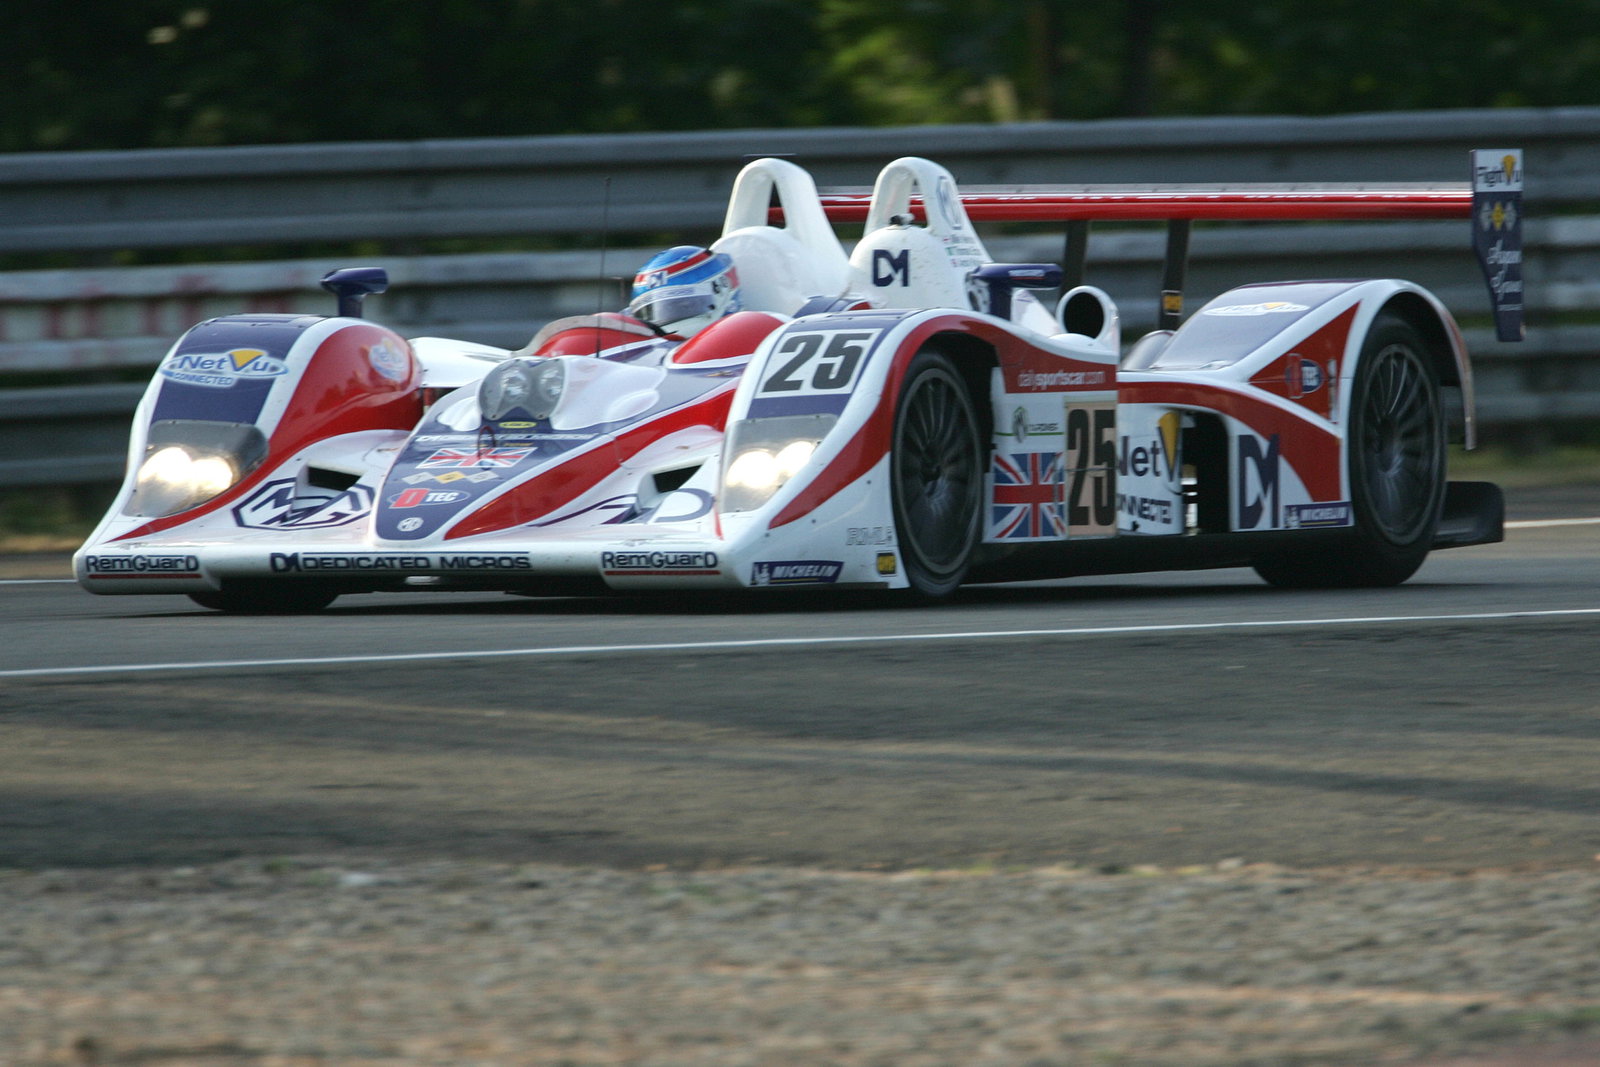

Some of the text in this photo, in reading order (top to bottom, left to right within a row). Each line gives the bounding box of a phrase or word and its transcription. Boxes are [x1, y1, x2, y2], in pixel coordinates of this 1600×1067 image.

[873, 249, 909, 287] DM
[178, 350, 269, 372] NetVu
[762, 332, 873, 393] 25
[174, 372, 234, 386] CONNECTED
[1068, 408, 1116, 527] 25
[1238, 434, 1280, 529] DM
[426, 492, 459, 502] TEC
[1300, 506, 1348, 521] MICHELIN
[302, 557, 431, 570] DEDICATED
[440, 556, 532, 569] MICROS
[771, 565, 839, 578] MICHELIN
